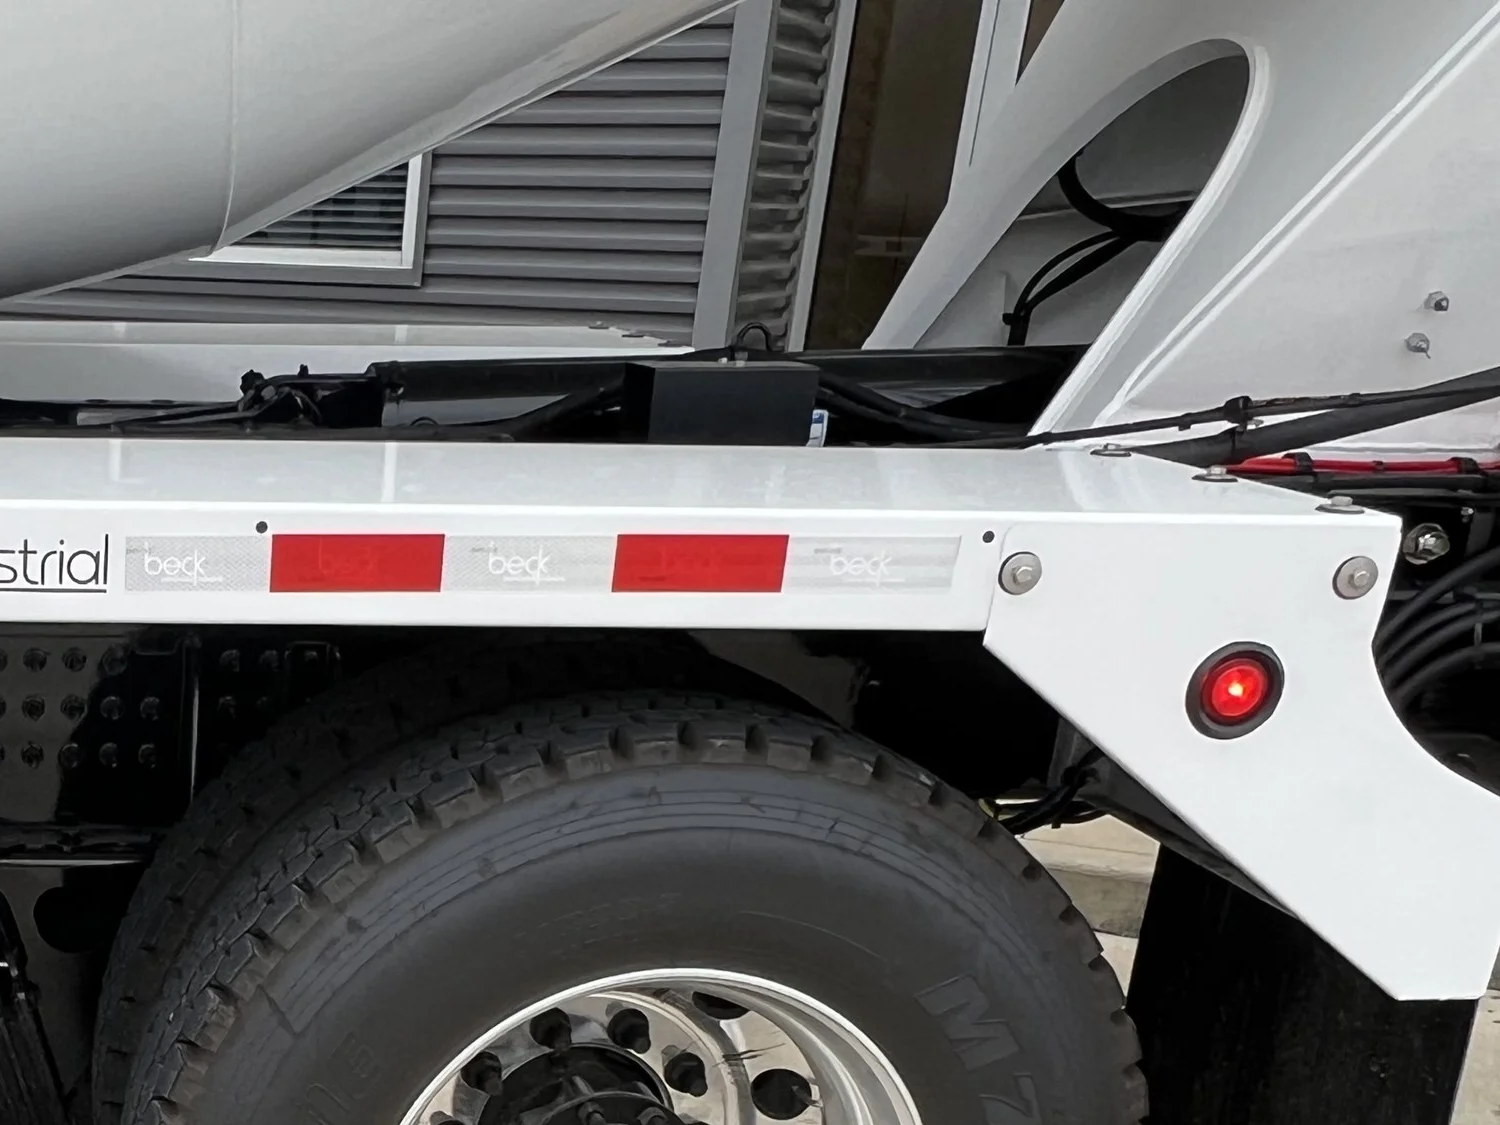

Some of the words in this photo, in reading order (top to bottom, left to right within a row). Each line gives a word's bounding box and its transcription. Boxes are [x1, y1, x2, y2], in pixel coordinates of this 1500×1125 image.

[144, 541, 208, 587] beck
[487, 540, 551, 586] beck
[828, 543, 892, 587] beck
